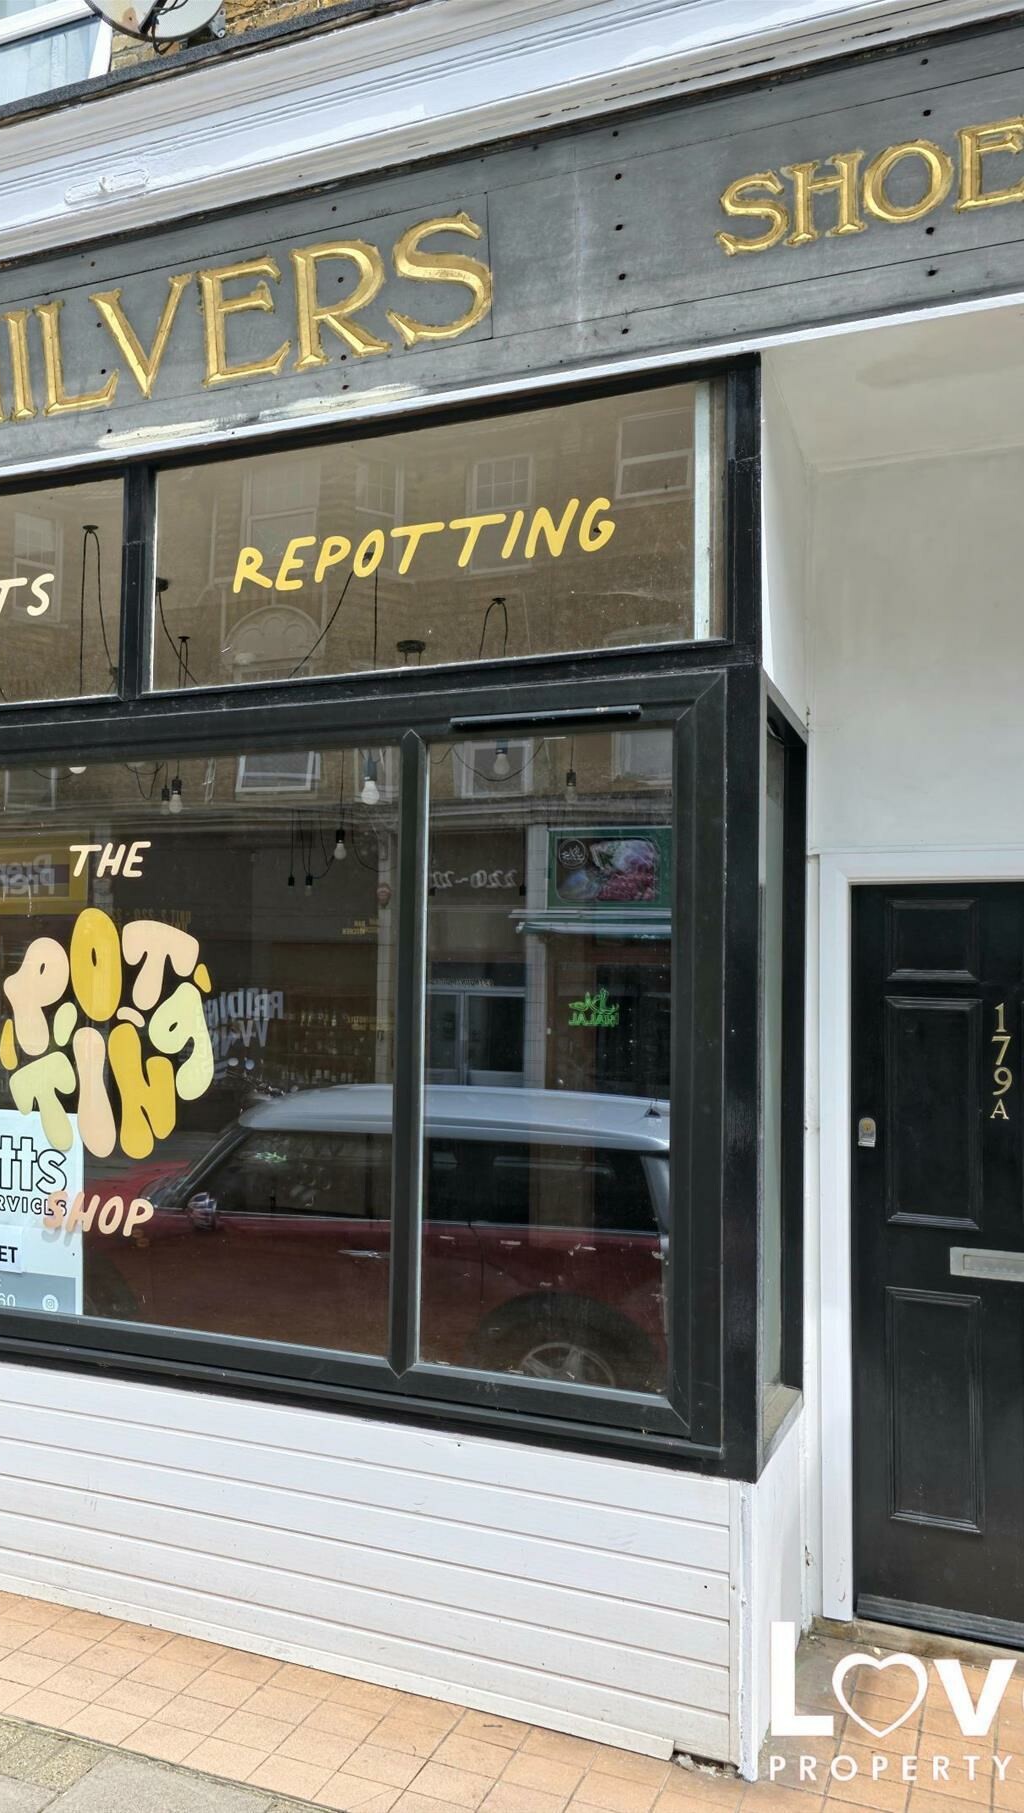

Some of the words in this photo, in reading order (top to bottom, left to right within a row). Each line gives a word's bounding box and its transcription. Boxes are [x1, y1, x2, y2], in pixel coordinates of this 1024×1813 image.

[232, 497, 617, 594] REPOTTING
[69, 841, 151, 878] THE
[43, 1190, 154, 1237] SHOP
